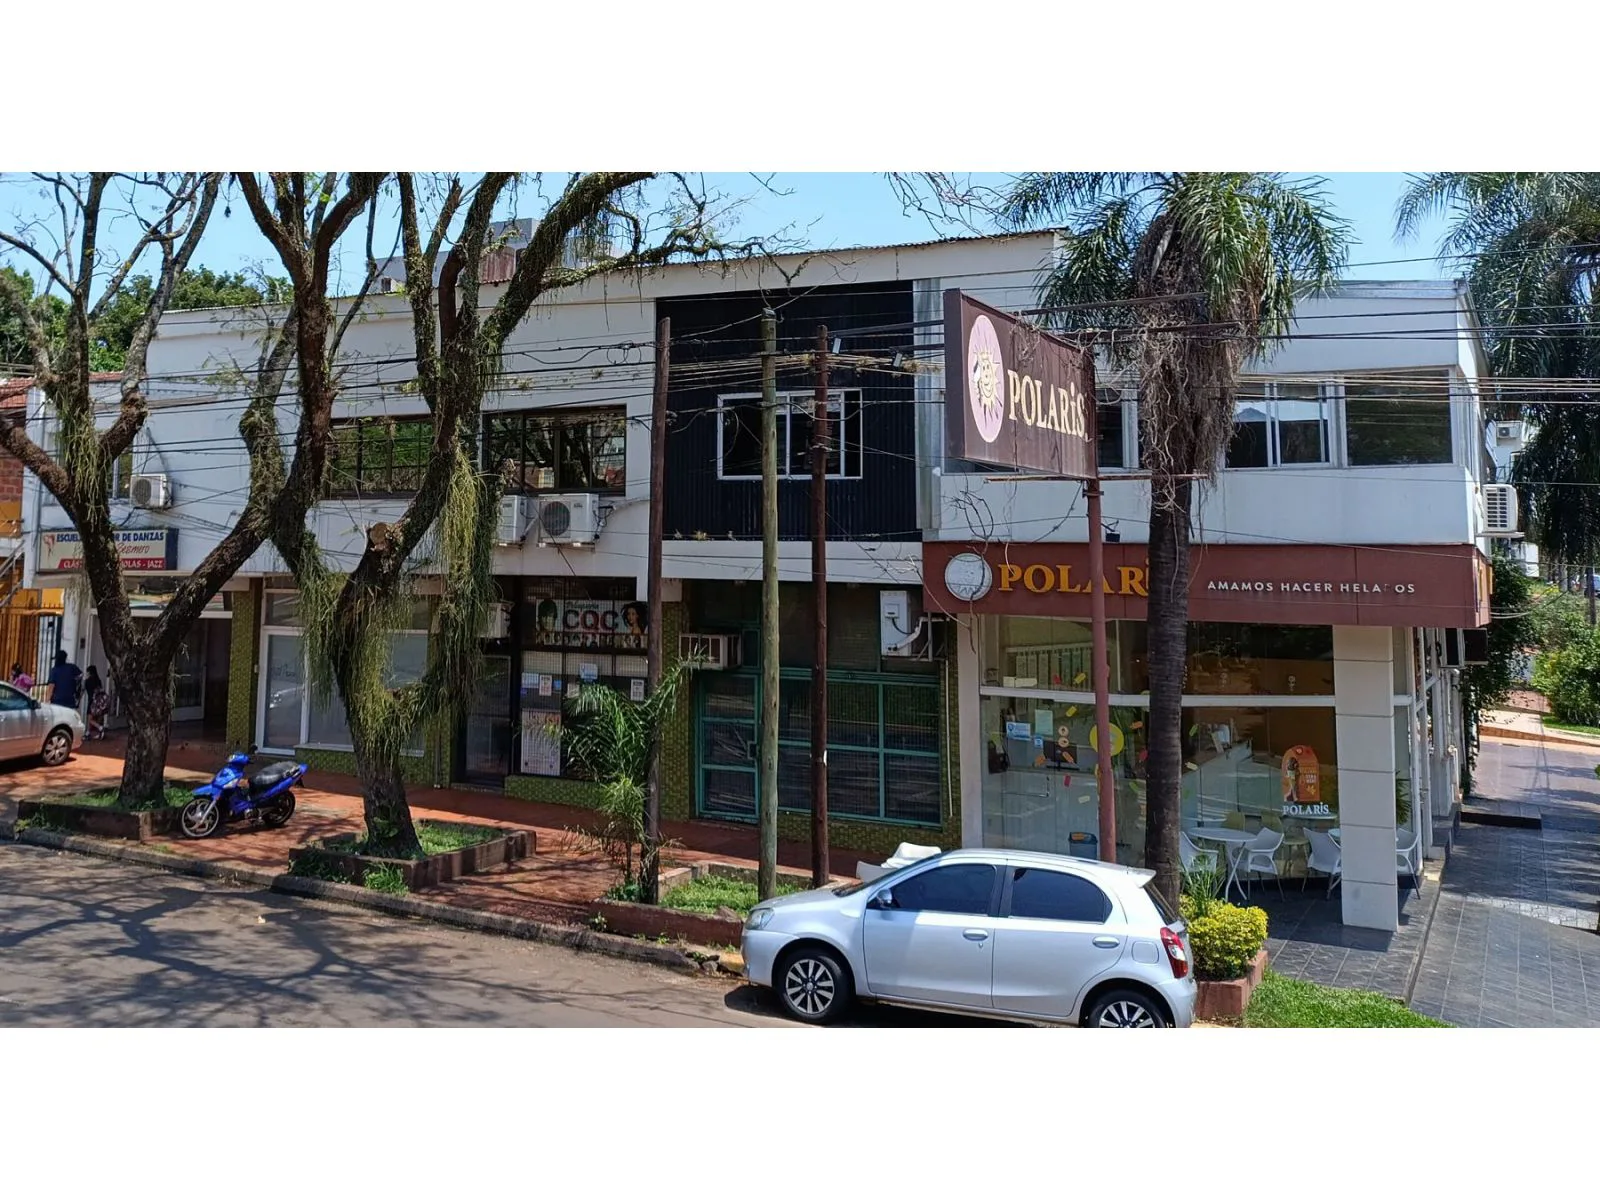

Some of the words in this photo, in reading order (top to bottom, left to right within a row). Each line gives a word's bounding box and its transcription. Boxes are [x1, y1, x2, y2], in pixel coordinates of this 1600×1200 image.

[56, 532, 80, 542] ESCUEL
[122, 532, 132, 541] DE
[133, 531, 164, 541] DANZAS
[1208, 581, 1273, 592] AMAMOS
[1281, 582, 1332, 593] HACER
[1340, 583, 1415, 593] HELAOS
[562, 609, 618, 631] CQC
